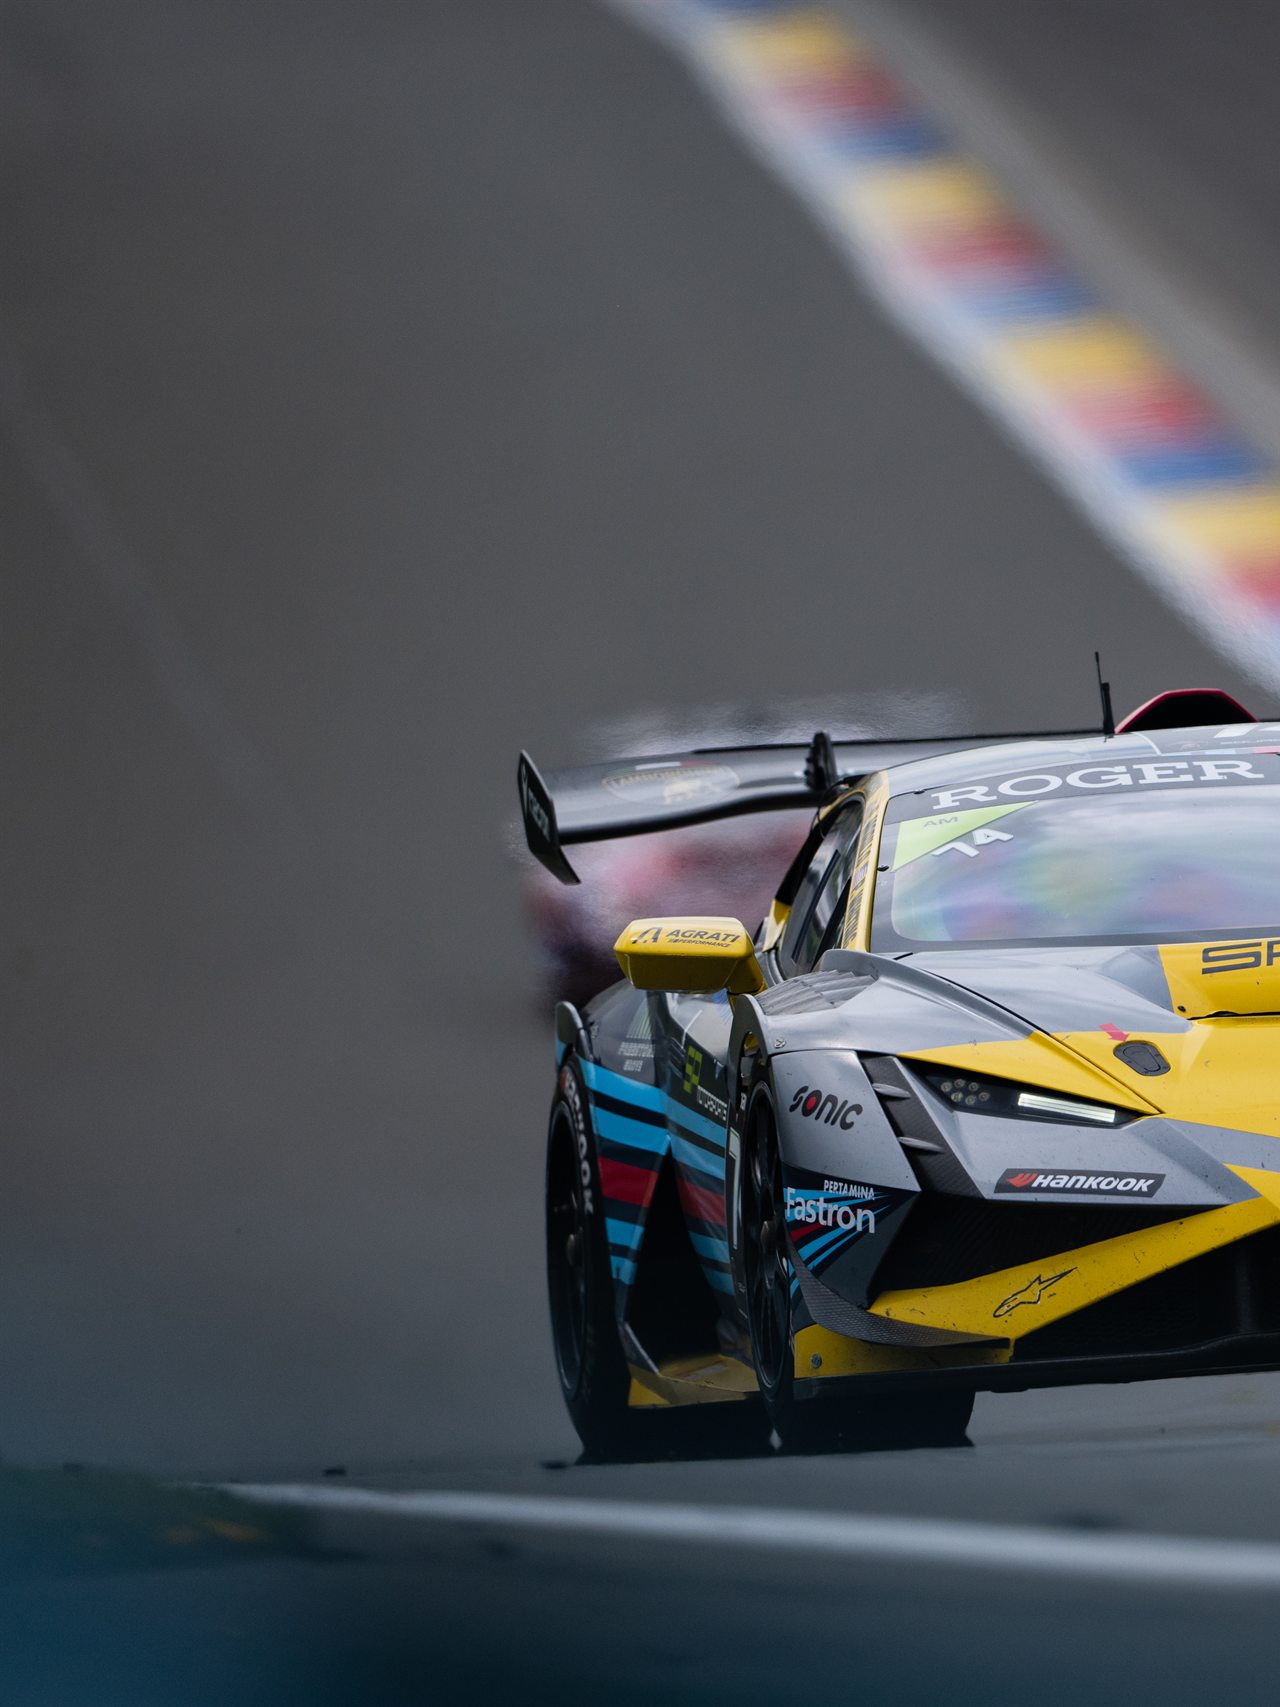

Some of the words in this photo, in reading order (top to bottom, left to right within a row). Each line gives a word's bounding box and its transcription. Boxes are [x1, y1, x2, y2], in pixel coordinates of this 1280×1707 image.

[933, 760, 1264, 810] ROGER
[923, 816, 959, 828] AM
[665, 929, 741, 943] AGRATI
[788, 1084, 864, 1131] SONIC
[823, 1180, 875, 1200] PERTAMINA
[1035, 1173, 1156, 1193] HANKOOK
[785, 1187, 876, 1233] Fastron
